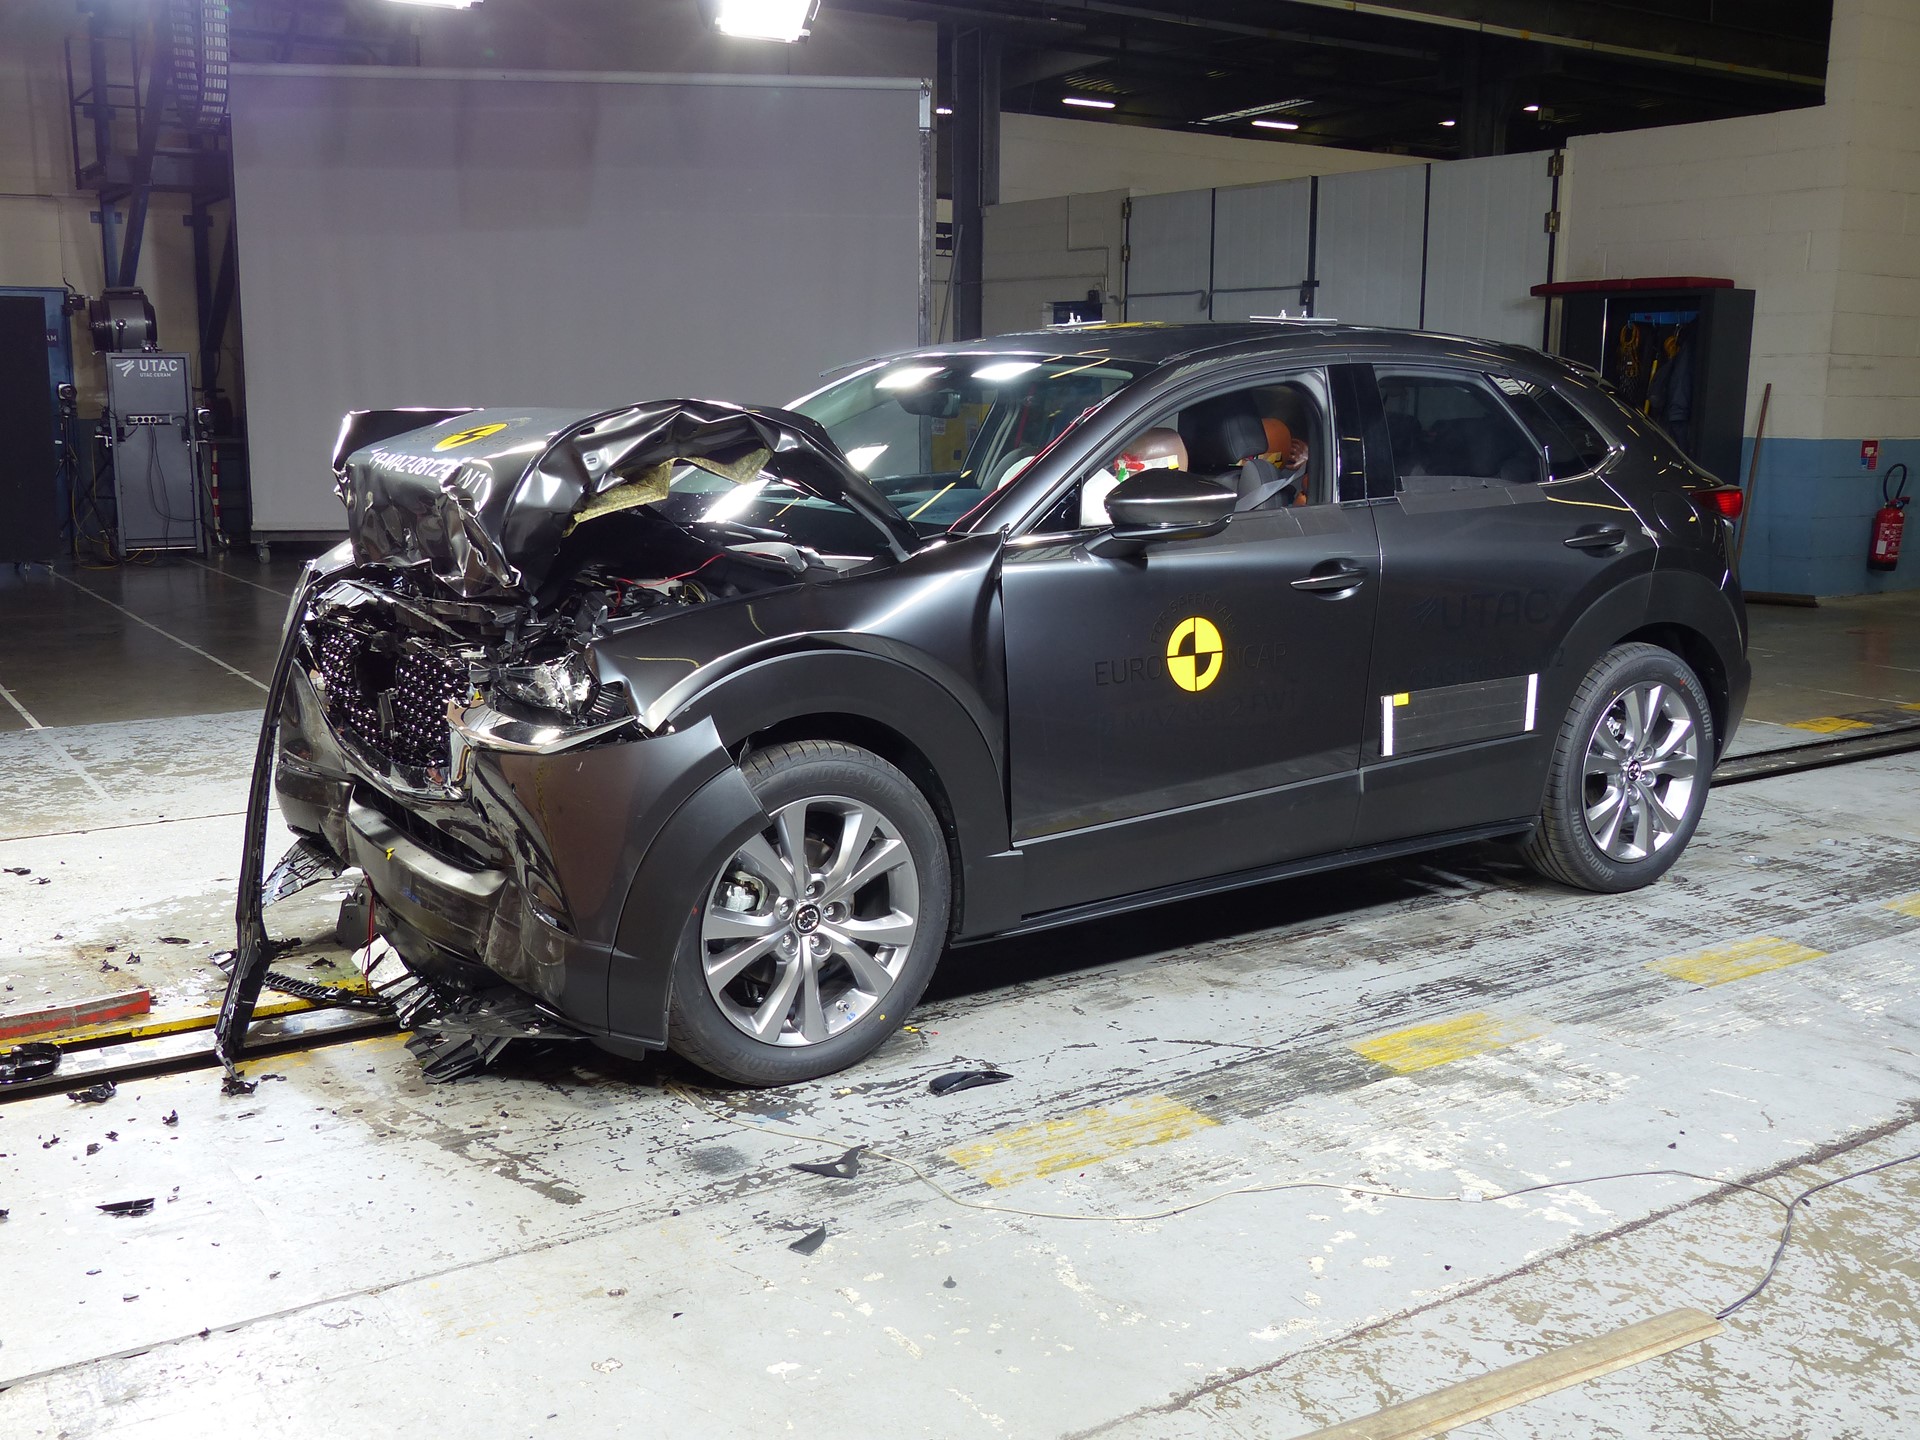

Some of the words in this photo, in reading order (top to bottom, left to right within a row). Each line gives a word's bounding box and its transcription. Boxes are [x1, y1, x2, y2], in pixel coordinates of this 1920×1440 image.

[139, 359, 178, 372] UTAC
[1441, 588, 1550, 631] UTAC
[1094, 654, 1163, 687] EURO
[1226, 641, 1288, 672] NCAP
[1674, 665, 1713, 740] BRIDGESTONE
[1570, 807, 1615, 880] BRIDGESTONE
